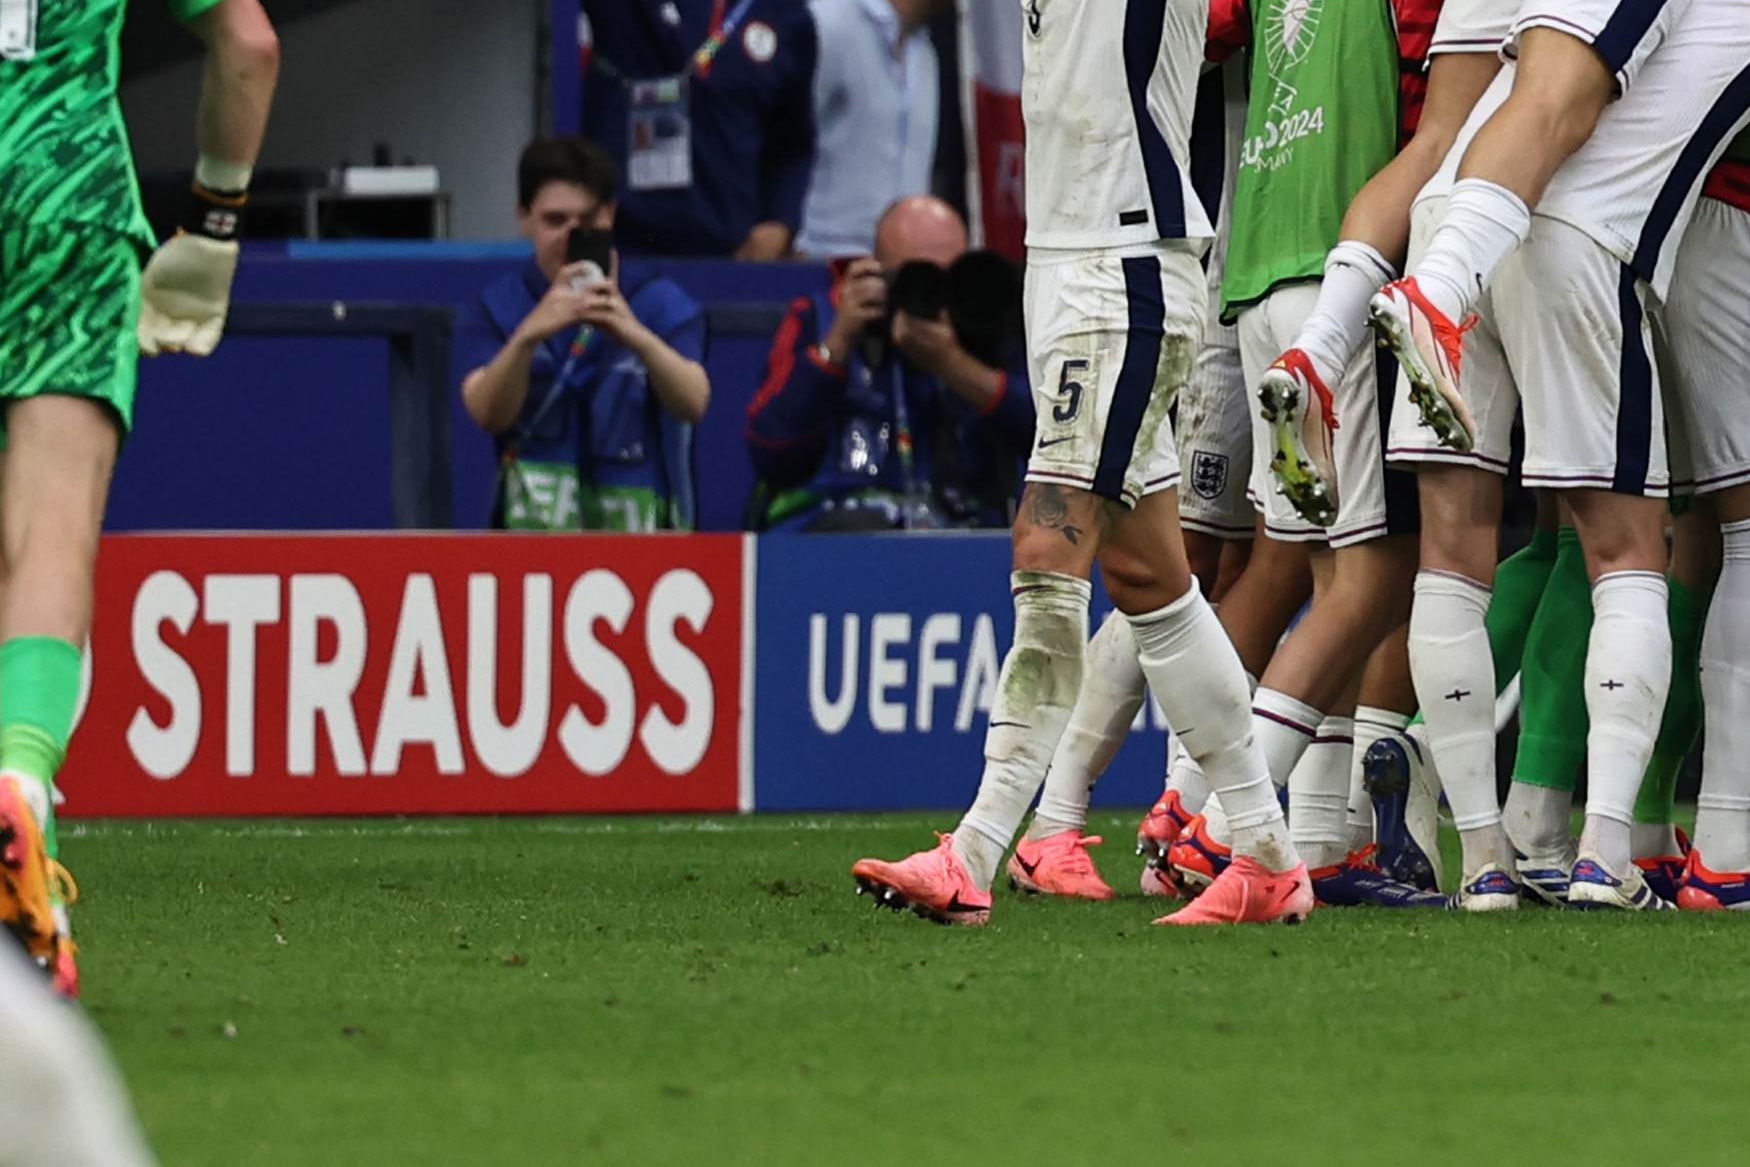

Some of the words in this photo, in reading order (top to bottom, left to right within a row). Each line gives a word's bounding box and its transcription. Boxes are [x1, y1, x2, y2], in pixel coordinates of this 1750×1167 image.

[1052, 358, 1091, 426] 5
[125, 568, 716, 780] STRAUSS
[808, 613, 1000, 734] UEFA
